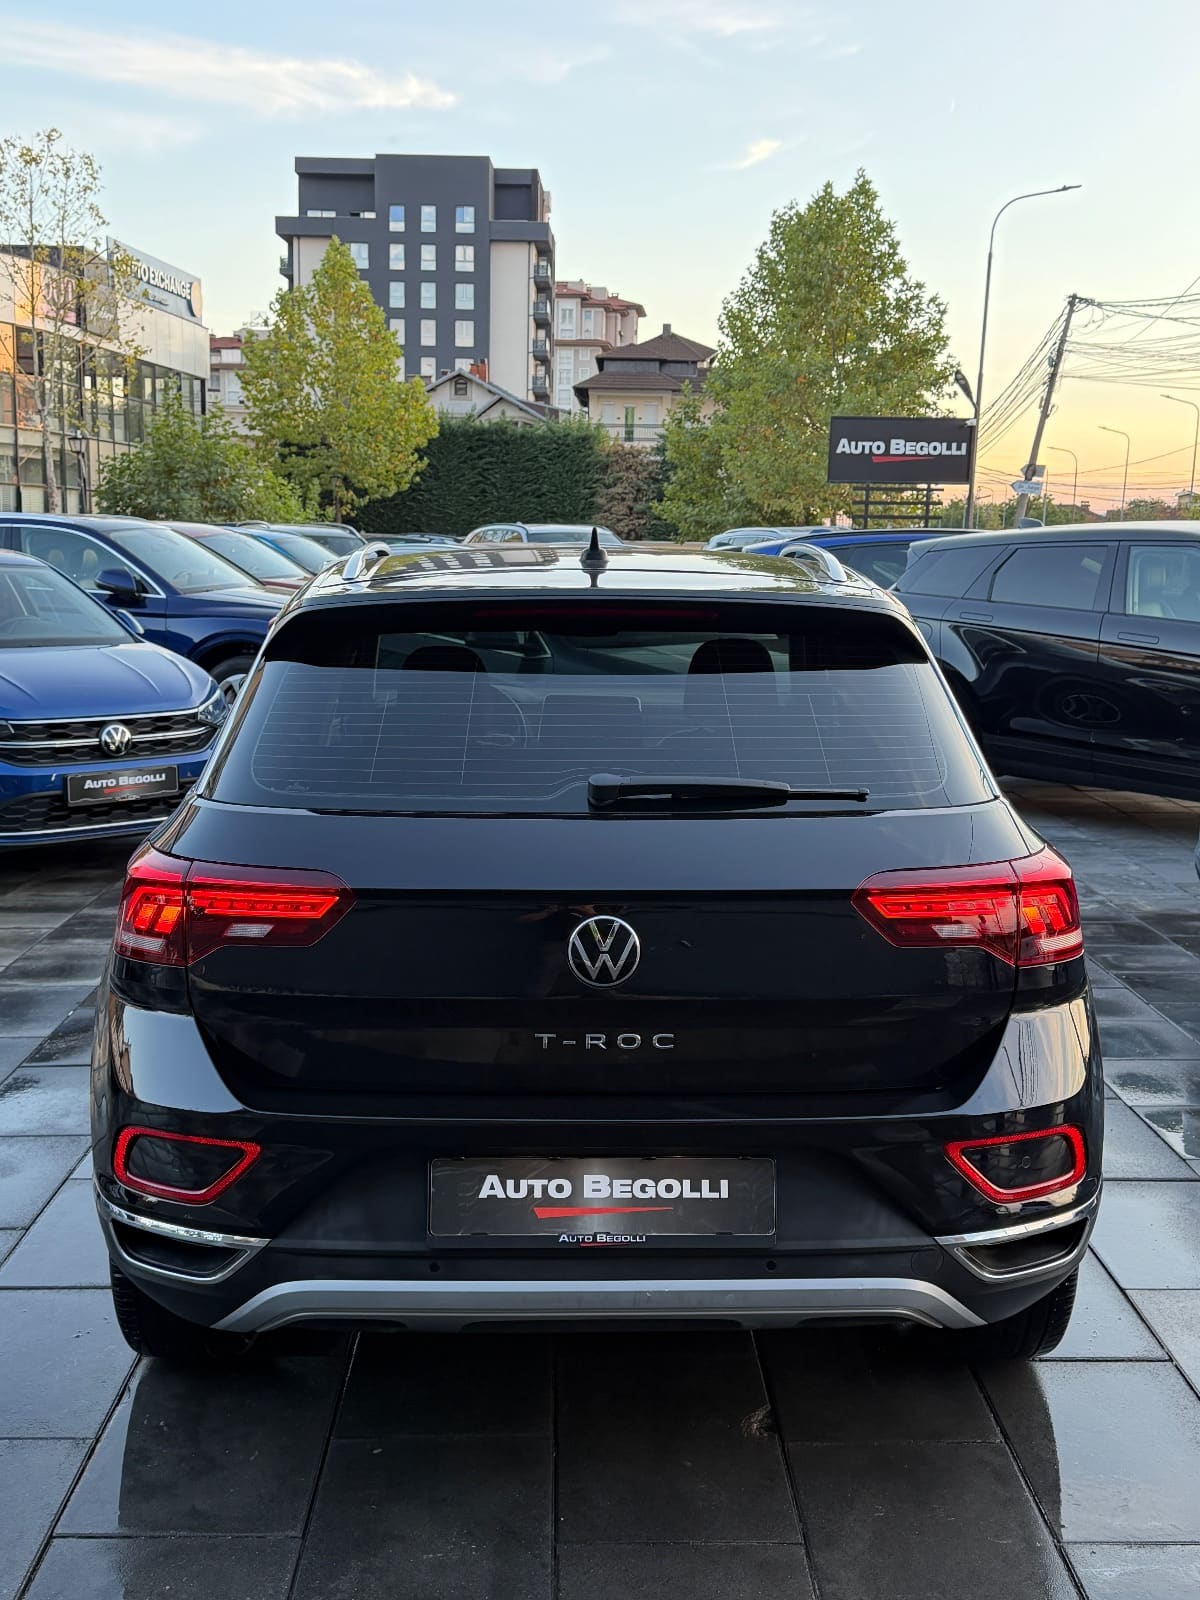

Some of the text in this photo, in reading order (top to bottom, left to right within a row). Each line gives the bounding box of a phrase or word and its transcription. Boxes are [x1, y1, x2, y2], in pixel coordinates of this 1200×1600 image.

[150, 266, 191, 300] EXCHANGE
[836, 438, 967, 456] AUTO BEGOLLI
[84, 772, 166, 790] AUTO BEGOLLI
[534, 1033, 676, 1050] T-ROC
[478, 1174, 729, 1199] AUTO BEGOLLI
[559, 1233, 646, 1243] AUTO BEGOLLI
